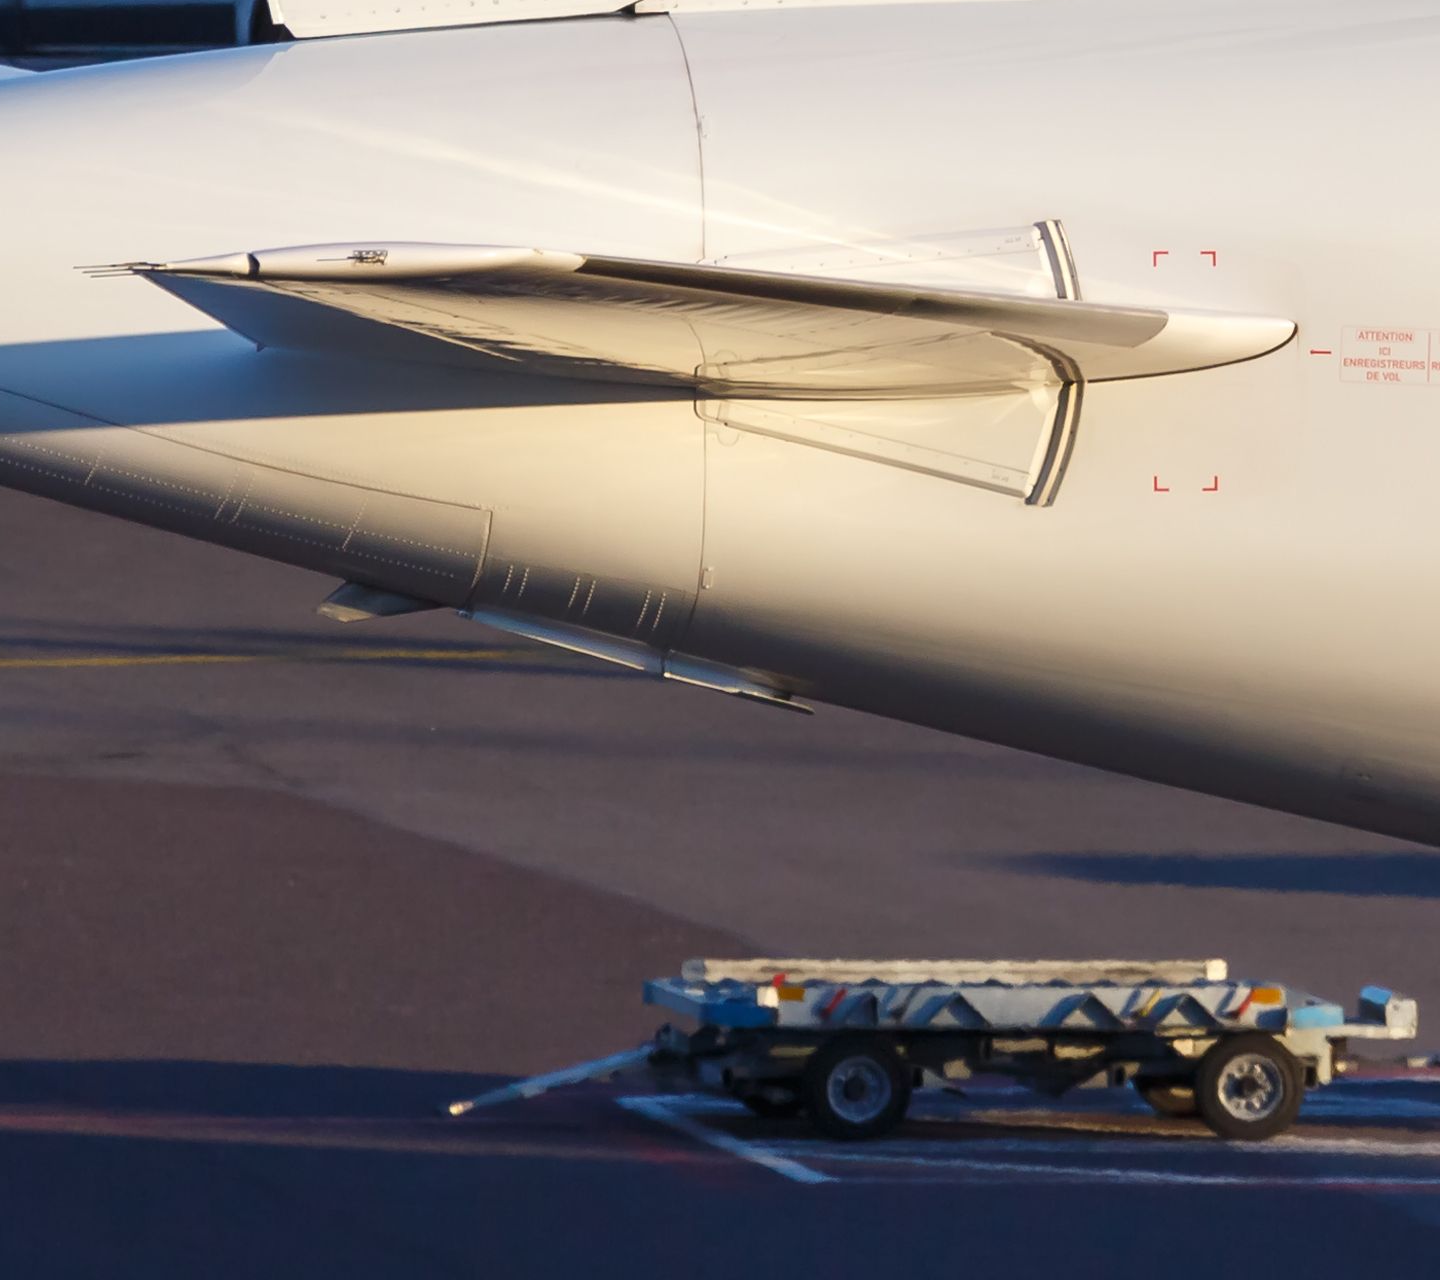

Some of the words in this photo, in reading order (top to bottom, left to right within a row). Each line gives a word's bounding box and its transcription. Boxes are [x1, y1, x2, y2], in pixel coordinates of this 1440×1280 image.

[1357, 331, 1413, 342] ATTENTION
[1378, 347, 1391, 356] ICI
[1343, 358, 1425, 370] ENREGISTREURS
[1366, 371, 1379, 381] DE
[1382, 371, 1401, 382] VOL
